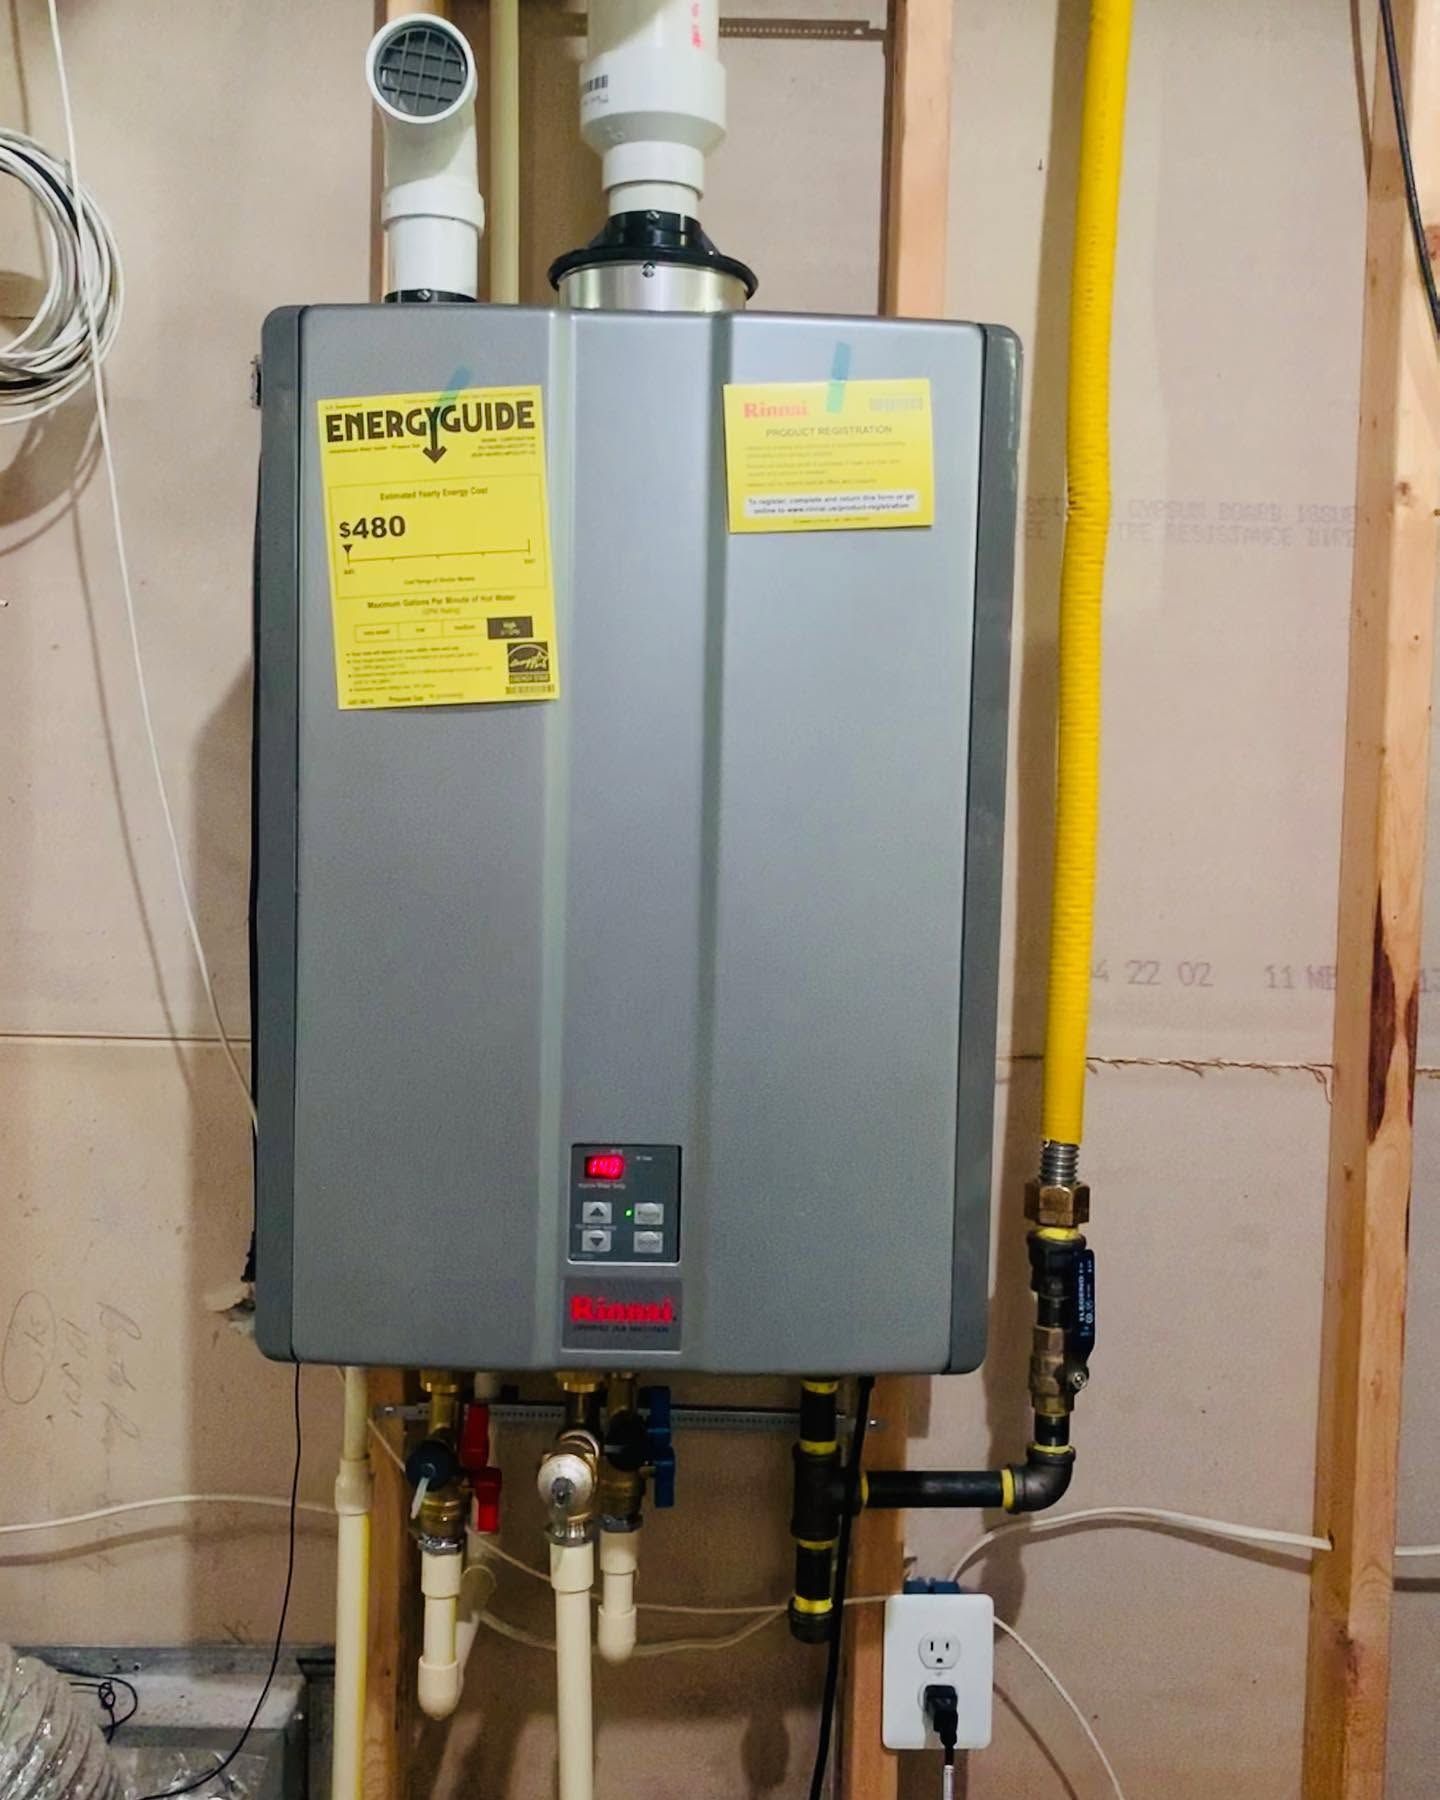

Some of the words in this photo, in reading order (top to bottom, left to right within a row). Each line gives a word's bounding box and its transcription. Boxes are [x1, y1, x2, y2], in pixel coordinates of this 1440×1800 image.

[744, 400, 808, 418] Rinnai
[326, 400, 535, 443] ENERGYGUIDE
[765, 427, 815, 438] PRODUCT
[817, 424, 892, 437] REGISTRATION
[380, 491, 417, 501] Estimated
[418, 490, 441, 499] Yearly
[442, 488, 469, 497] Energy
[471, 486, 488, 495] Cost
[339, 515, 406, 539] $480
[1125, 960, 1162, 986] 22
[1177, 960, 1215, 987] 02
[570, 1295, 674, 1323] Rinnai
